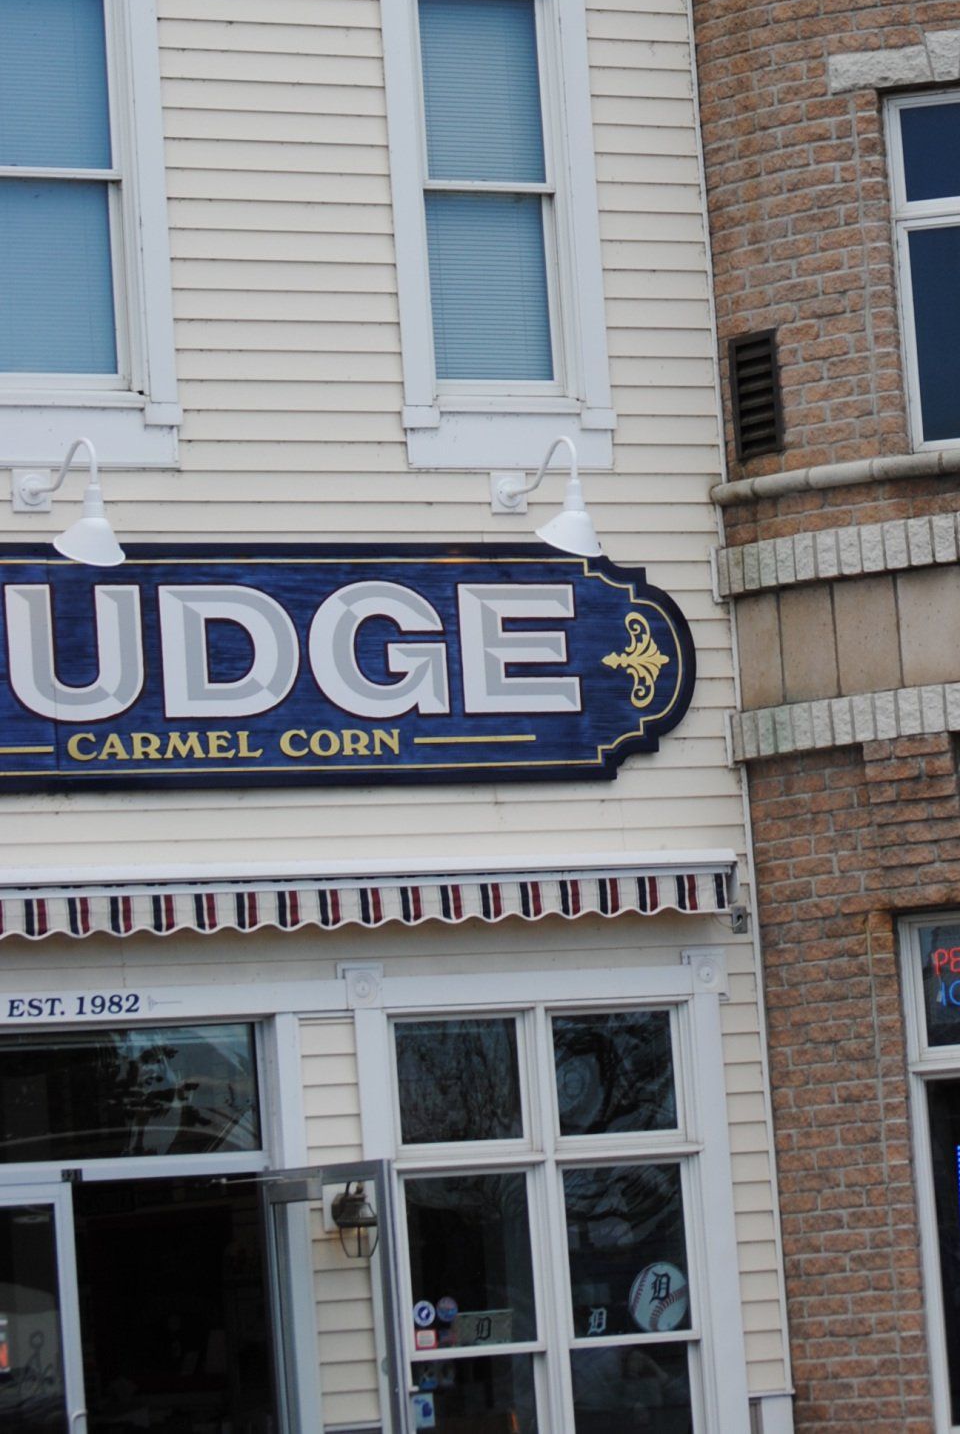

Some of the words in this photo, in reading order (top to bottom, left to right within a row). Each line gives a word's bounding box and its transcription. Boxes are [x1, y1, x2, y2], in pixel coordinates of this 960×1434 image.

[3, 580, 583, 723] UDGE
[66, 730, 263, 761] CARMEL
[279, 728, 401, 758] CORN
[7, 997, 66, 1018] EST.
[75, 993, 141, 1016] 1982
